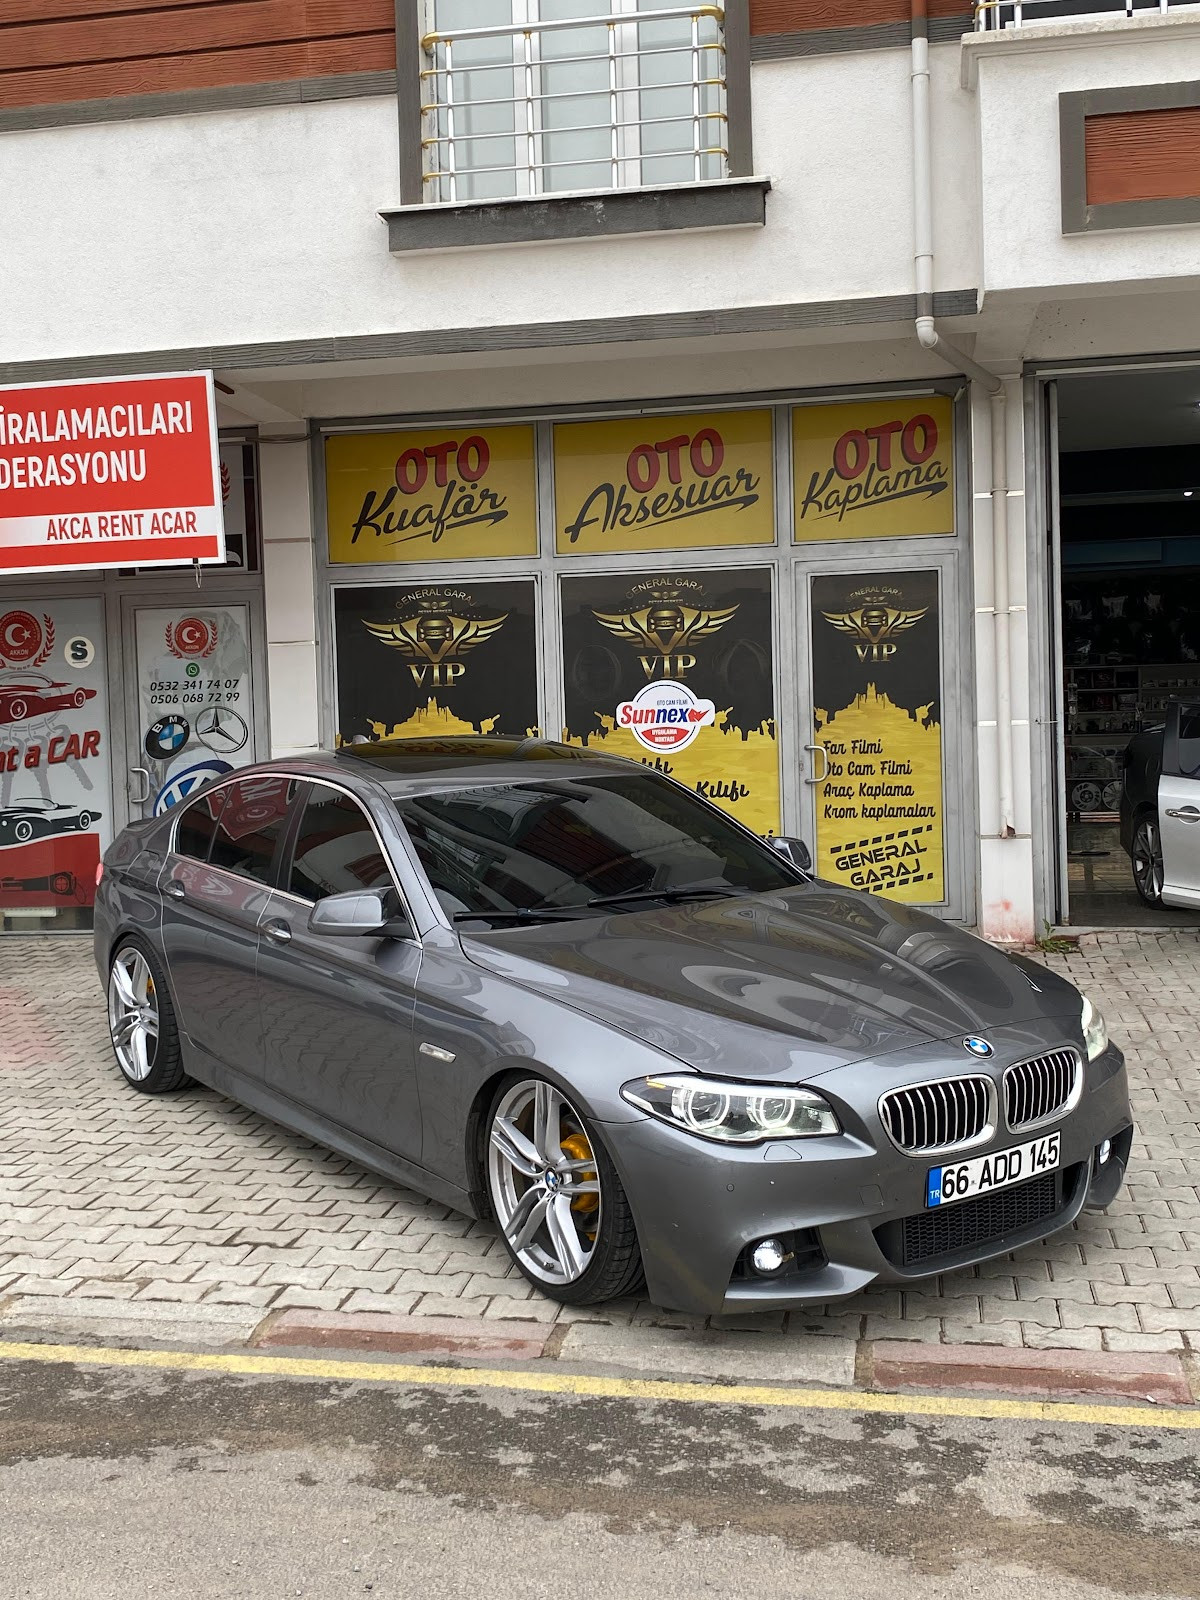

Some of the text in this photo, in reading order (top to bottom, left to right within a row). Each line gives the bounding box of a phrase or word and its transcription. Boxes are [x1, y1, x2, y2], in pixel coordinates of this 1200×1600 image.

[833, 414, 938, 480] OTO
[0, 449, 147, 490] DERASYONU
[395, 435, 490, 494] OTO
[626, 428, 724, 493] OTO
[800, 461, 948, 522] Kaplama
[351, 479, 507, 543] Kuaför
[564, 467, 761, 543] Aksesuar
[47, 511, 198, 541] AKCA RENT ACAR
[395, 588, 442, 609] GENERAL
[846, 586, 880, 602] ENERAL
[71, 640, 88, 660] S
[854, 643, 897, 662] VIP
[406, 662, 466, 688] VIP
[637, 654, 697, 680] VIP
[150, 679, 240, 691] 0532 341 74 07
[150, 692, 240, 704] 0506 068 72 99
[620, 705, 690, 725] Sunnex
[24, 745, 41, 769] a
[47, 730, 101, 764] CAR
[823, 739, 883, 754] Far Filmi
[847, 761, 876, 776] Cam
[880, 760, 912, 775] Filmi
[823, 782, 914, 800] Araç Kaplama
[824, 803, 936, 821] Krom kaplamalar
[835, 839, 928, 871] GENERAL
[850, 858, 921, 886] GARAJ
[930, 1136, 1059, 1199] TR 66 ADD 145
